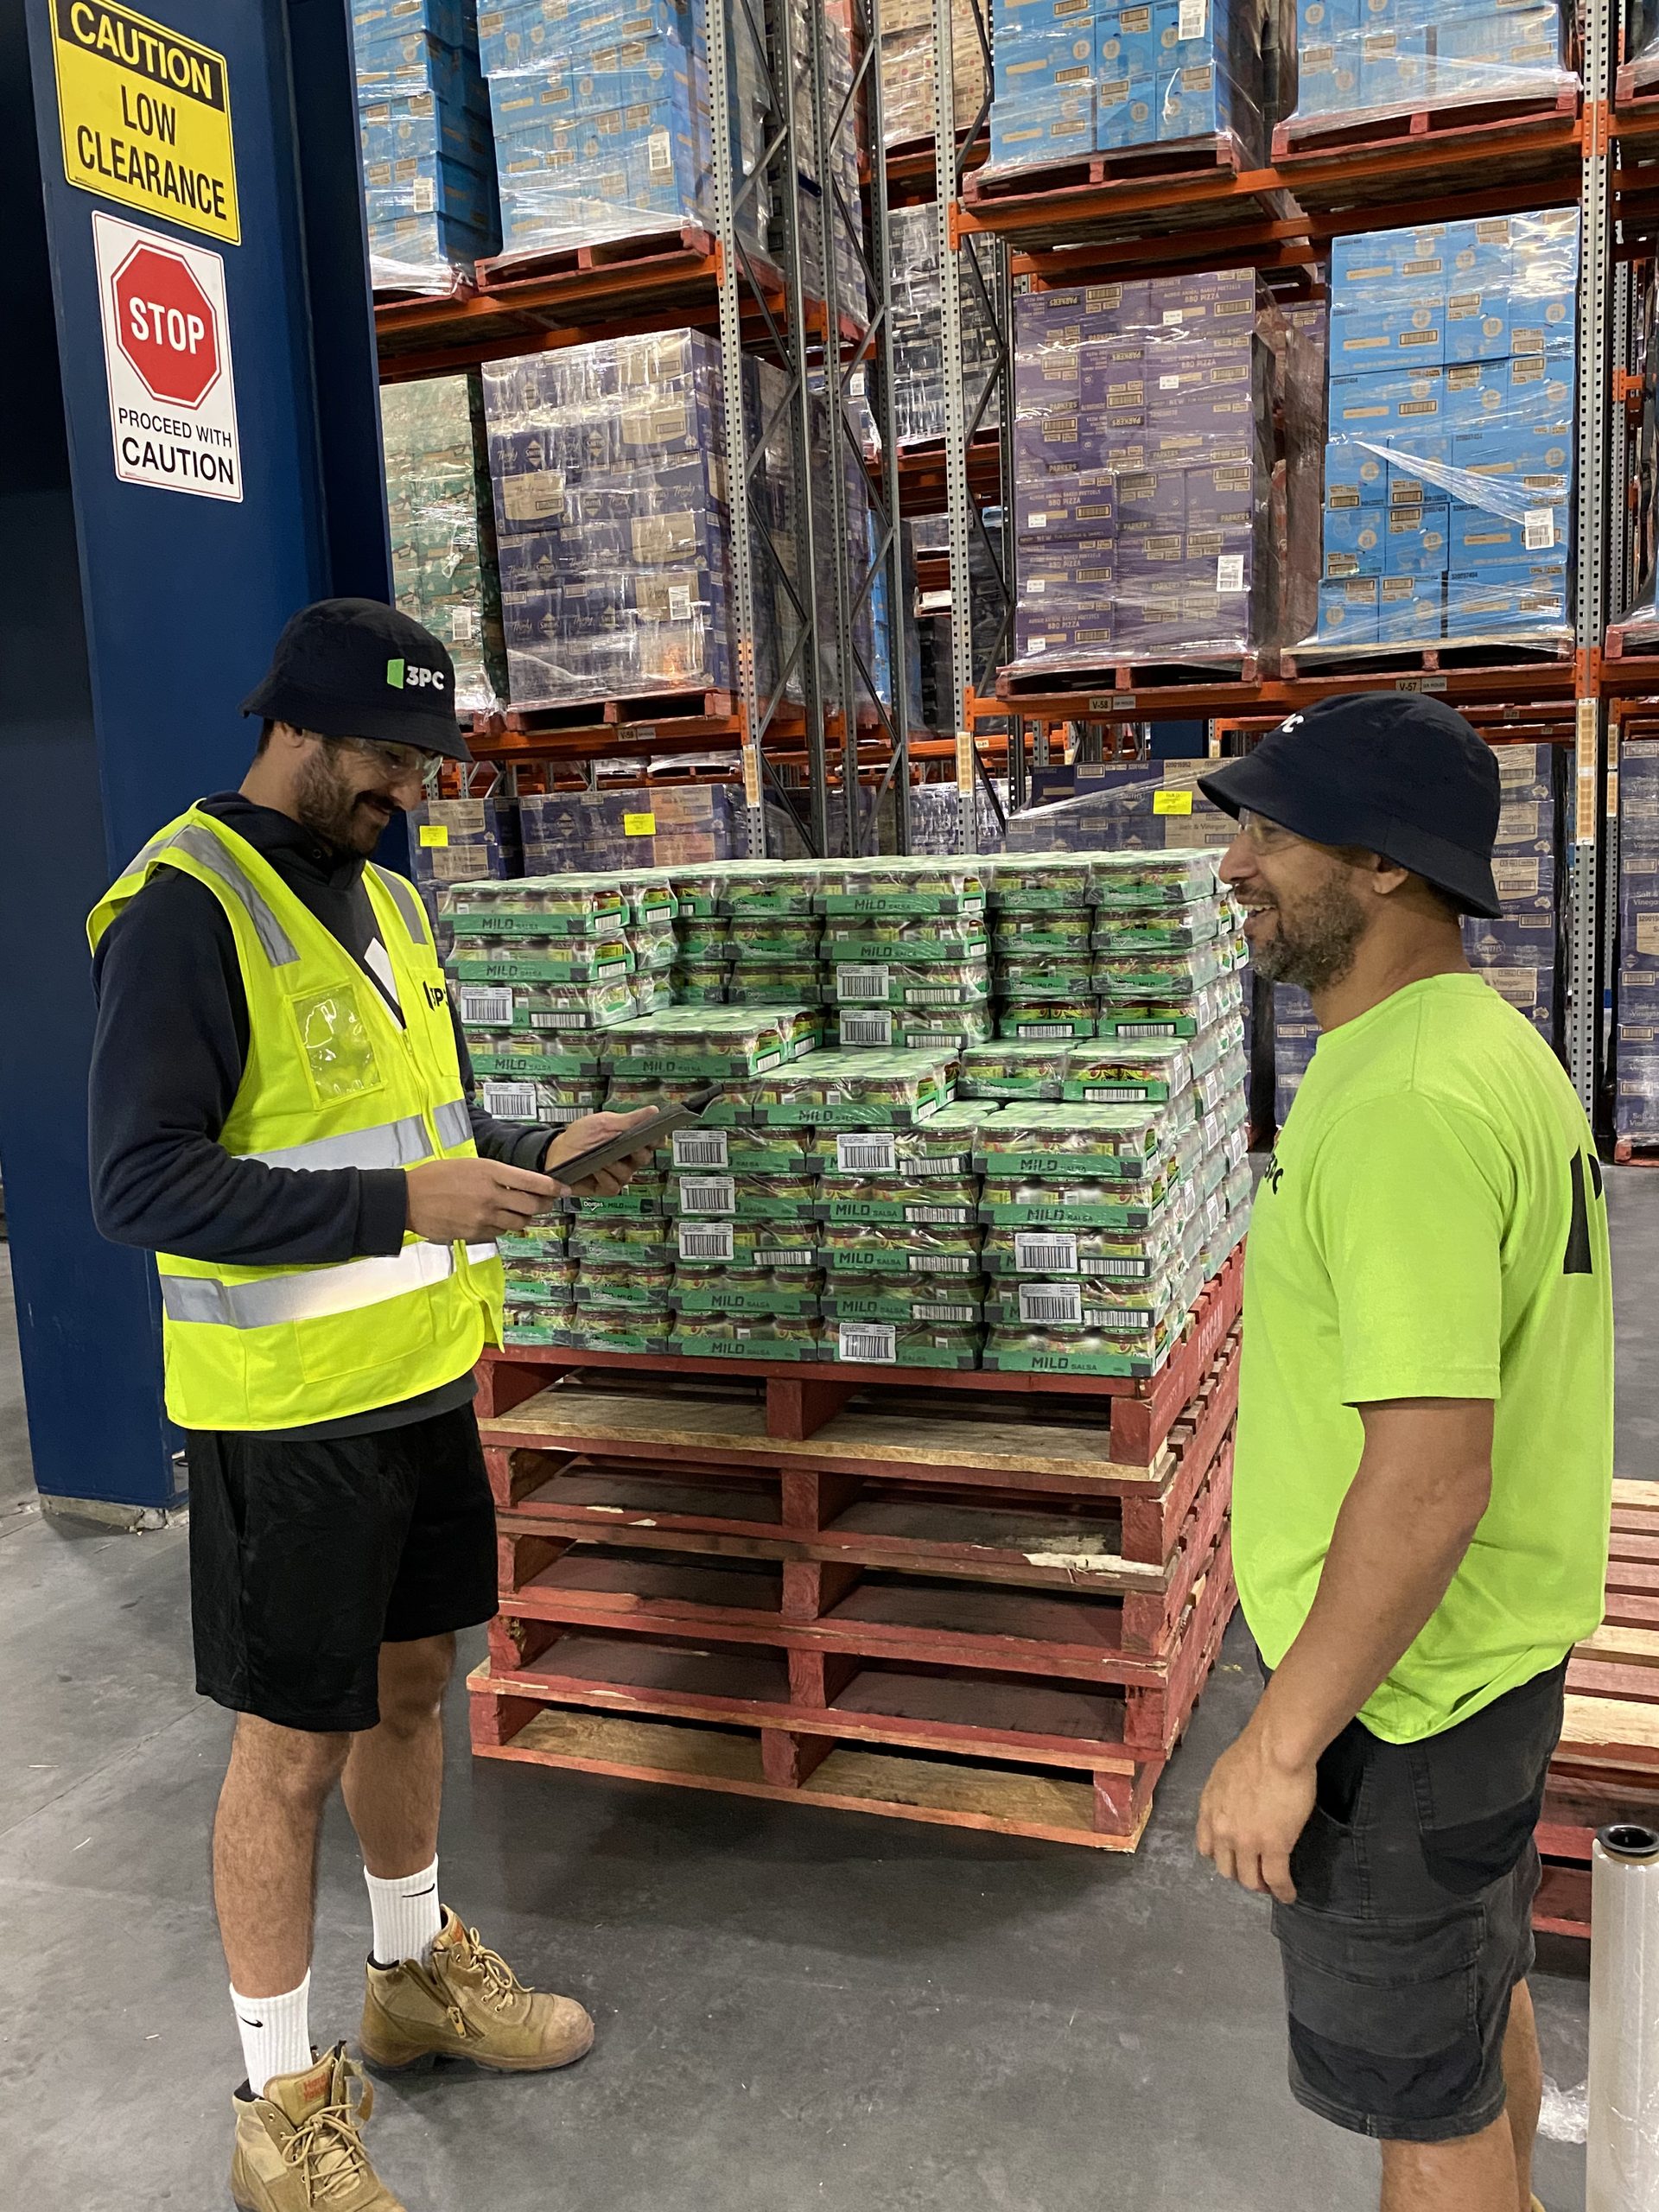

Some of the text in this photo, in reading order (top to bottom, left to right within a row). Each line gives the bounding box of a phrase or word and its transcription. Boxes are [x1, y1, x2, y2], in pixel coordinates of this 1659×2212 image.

[70, 2, 213, 99] CAUTION
[121, 85, 175, 146] LOW
[77, 125, 227, 220] CLEARANCE
[1201, 292, 1220, 301] PIZZA
[130, 296, 204, 354] STOP
[118, 407, 232, 448] PROCEED WITH
[1112, 416, 1141, 427] PARKERS
[122, 436, 234, 485] CAUTION
[1220, 511, 1250, 522] PARKERS
[1399, 682, 1417, 692] V-57
[1092, 699, 1108, 709] V-58
[855, 899, 886, 910] MILD
[482, 918, 513, 930] MILD
[861, 947, 892, 957] MILD
[486, 965, 518, 976] MILD
[495, 1058, 526, 1071] MILD
[643, 1061, 676, 1072] MILD
[799, 1110, 834, 1122] MILD
[1020, 1160, 1058, 1172] MILD
[836, 1205, 870, 1217] MILD
[1027, 1209, 1065, 1221] MILD
[840, 1253, 874, 1264] MILD
[712, 1295, 744, 1307] MILD
[842, 1301, 877, 1313] MILD
[712, 1343, 745, 1355] MILD
[1032, 1357, 1069, 1370] MILD
